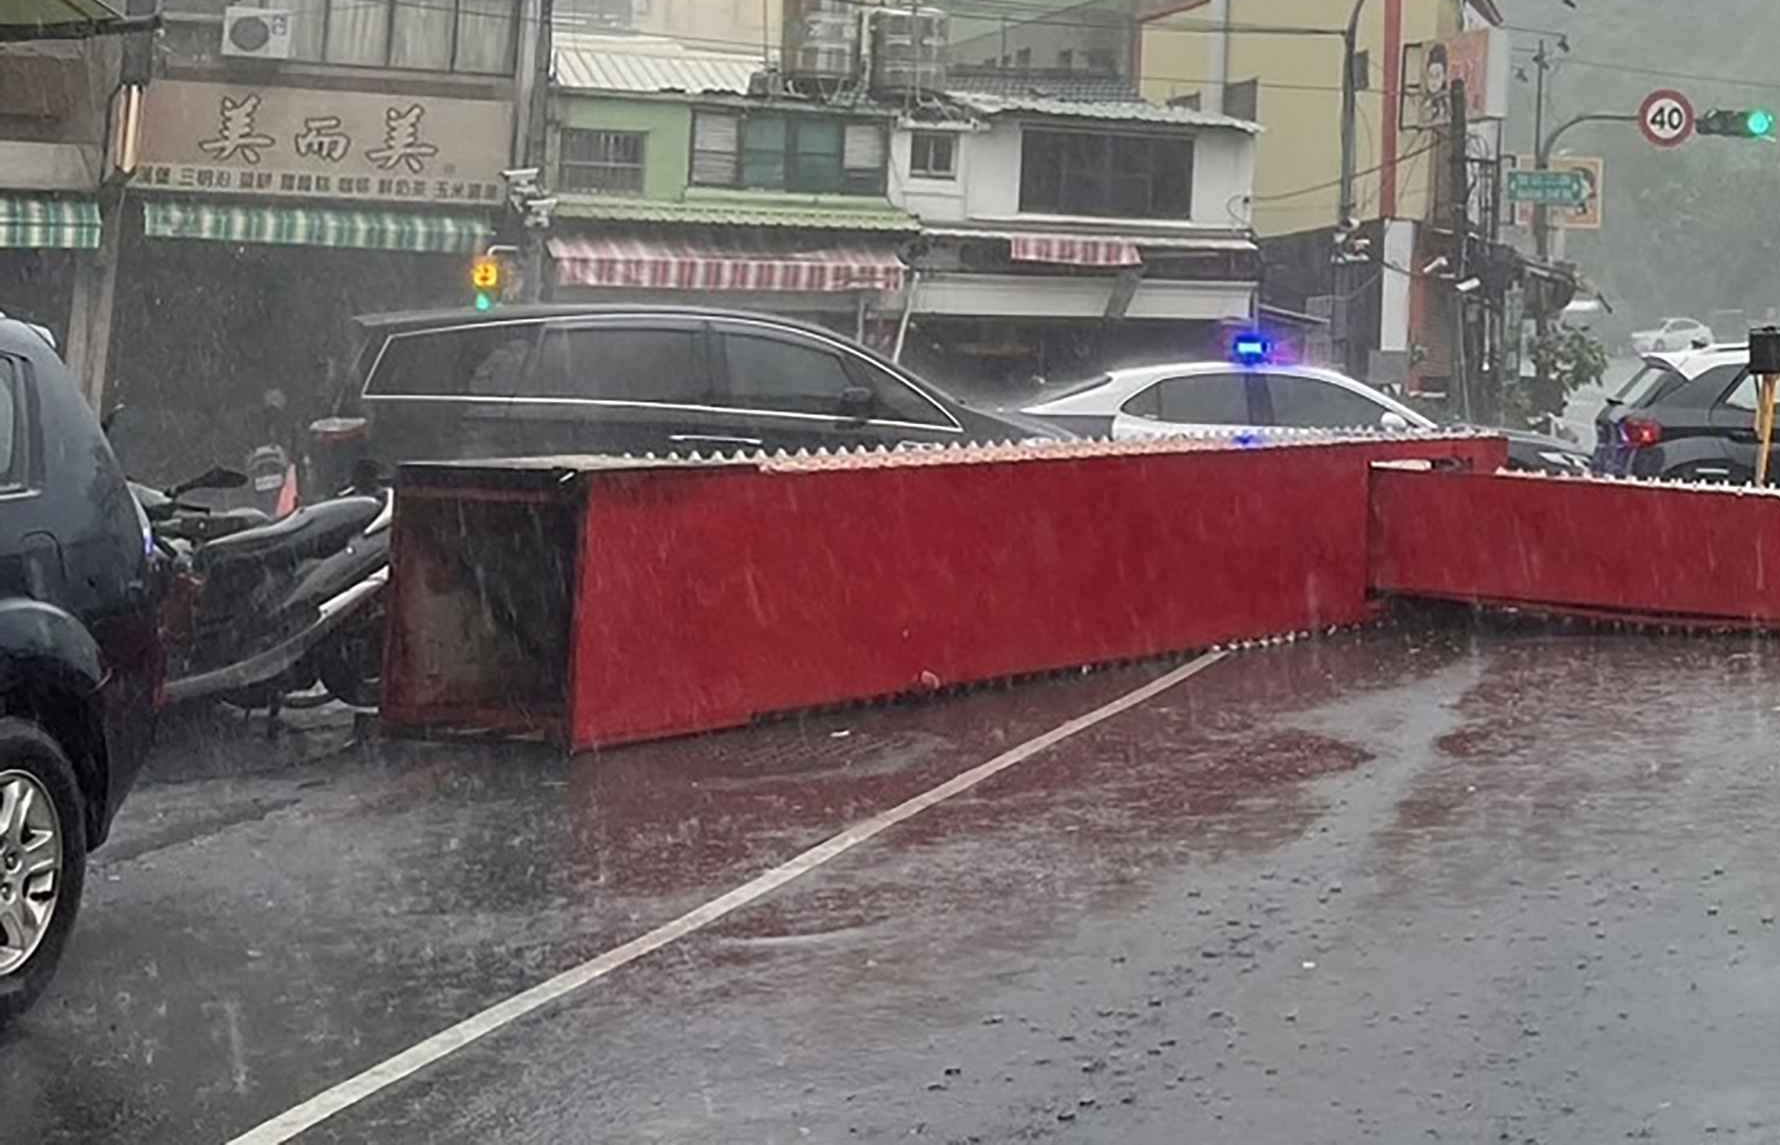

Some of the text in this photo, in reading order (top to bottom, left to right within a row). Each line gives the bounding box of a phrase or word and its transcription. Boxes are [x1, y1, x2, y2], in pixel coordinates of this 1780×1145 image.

[1649, 106, 1684, 131] 40
[198, 93, 438, 174] 美而美
[178, 167, 231, 188] 三明治
